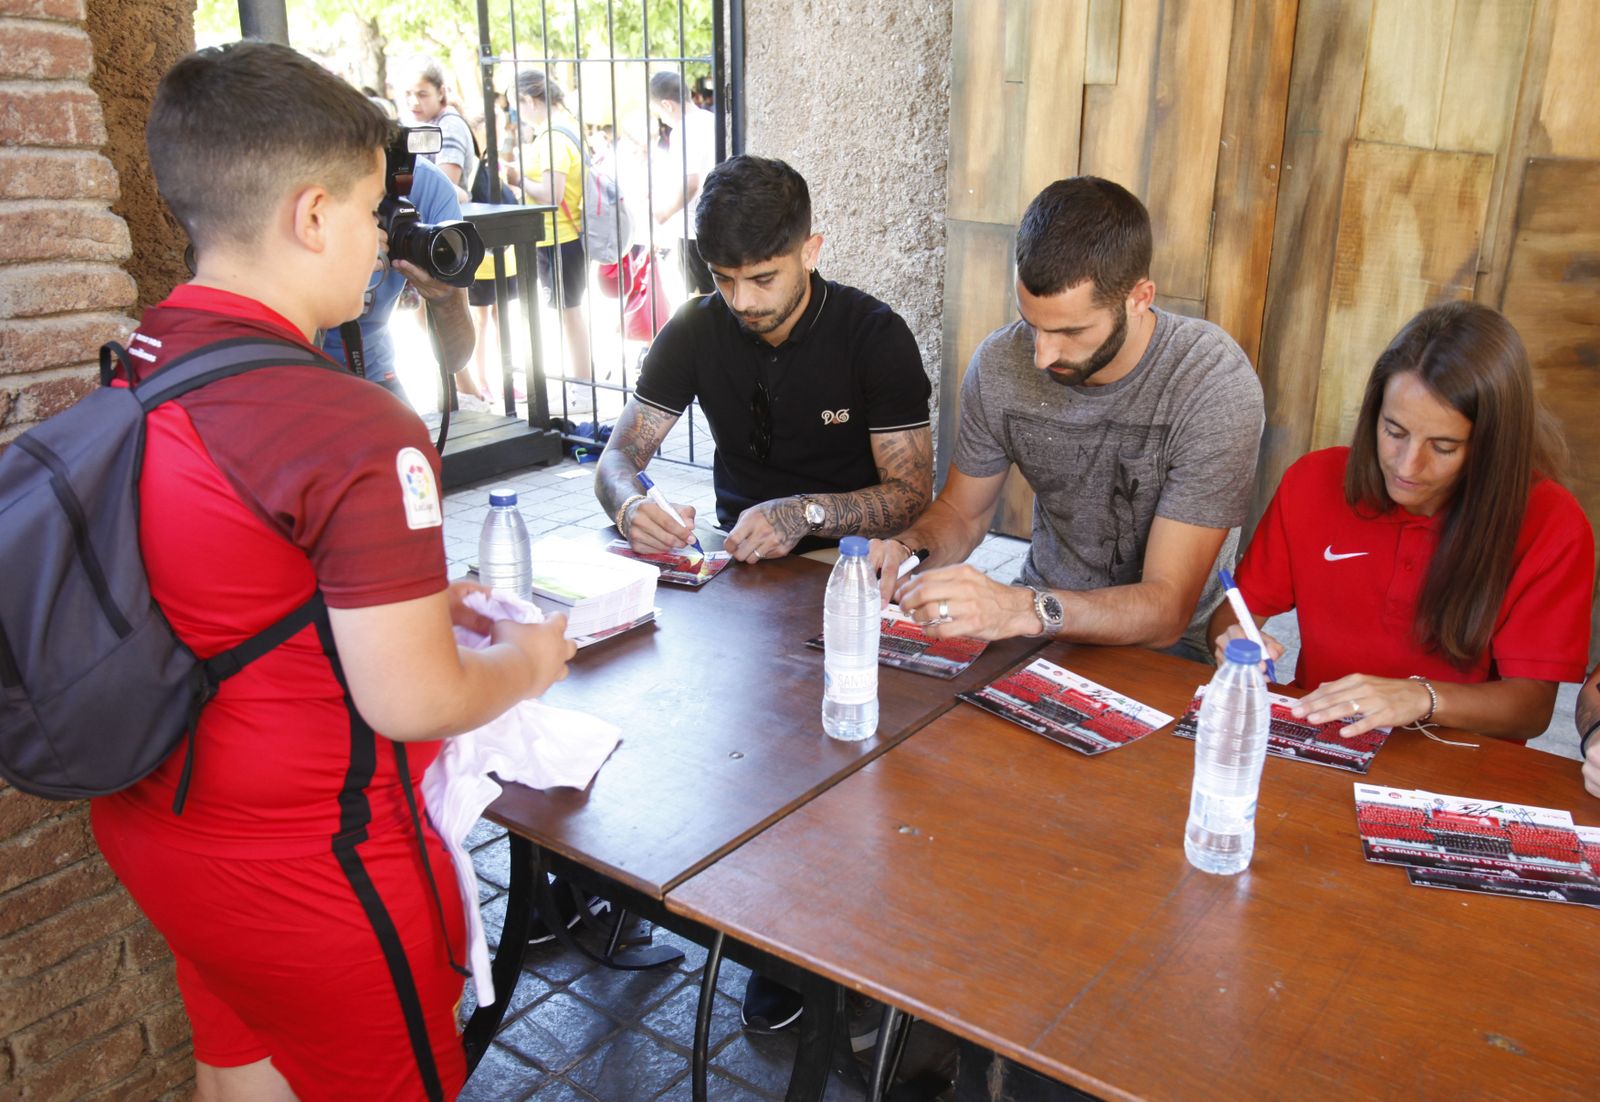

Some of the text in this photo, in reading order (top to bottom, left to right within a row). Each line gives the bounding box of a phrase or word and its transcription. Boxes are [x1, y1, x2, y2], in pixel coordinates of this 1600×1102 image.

[1385, 847, 1422, 856] FUTURO
[1424, 851, 1441, 859] DEL
[1442, 854, 1481, 864] SEVILLA
[1494, 861, 1577, 875] CONSTRUYENDO
